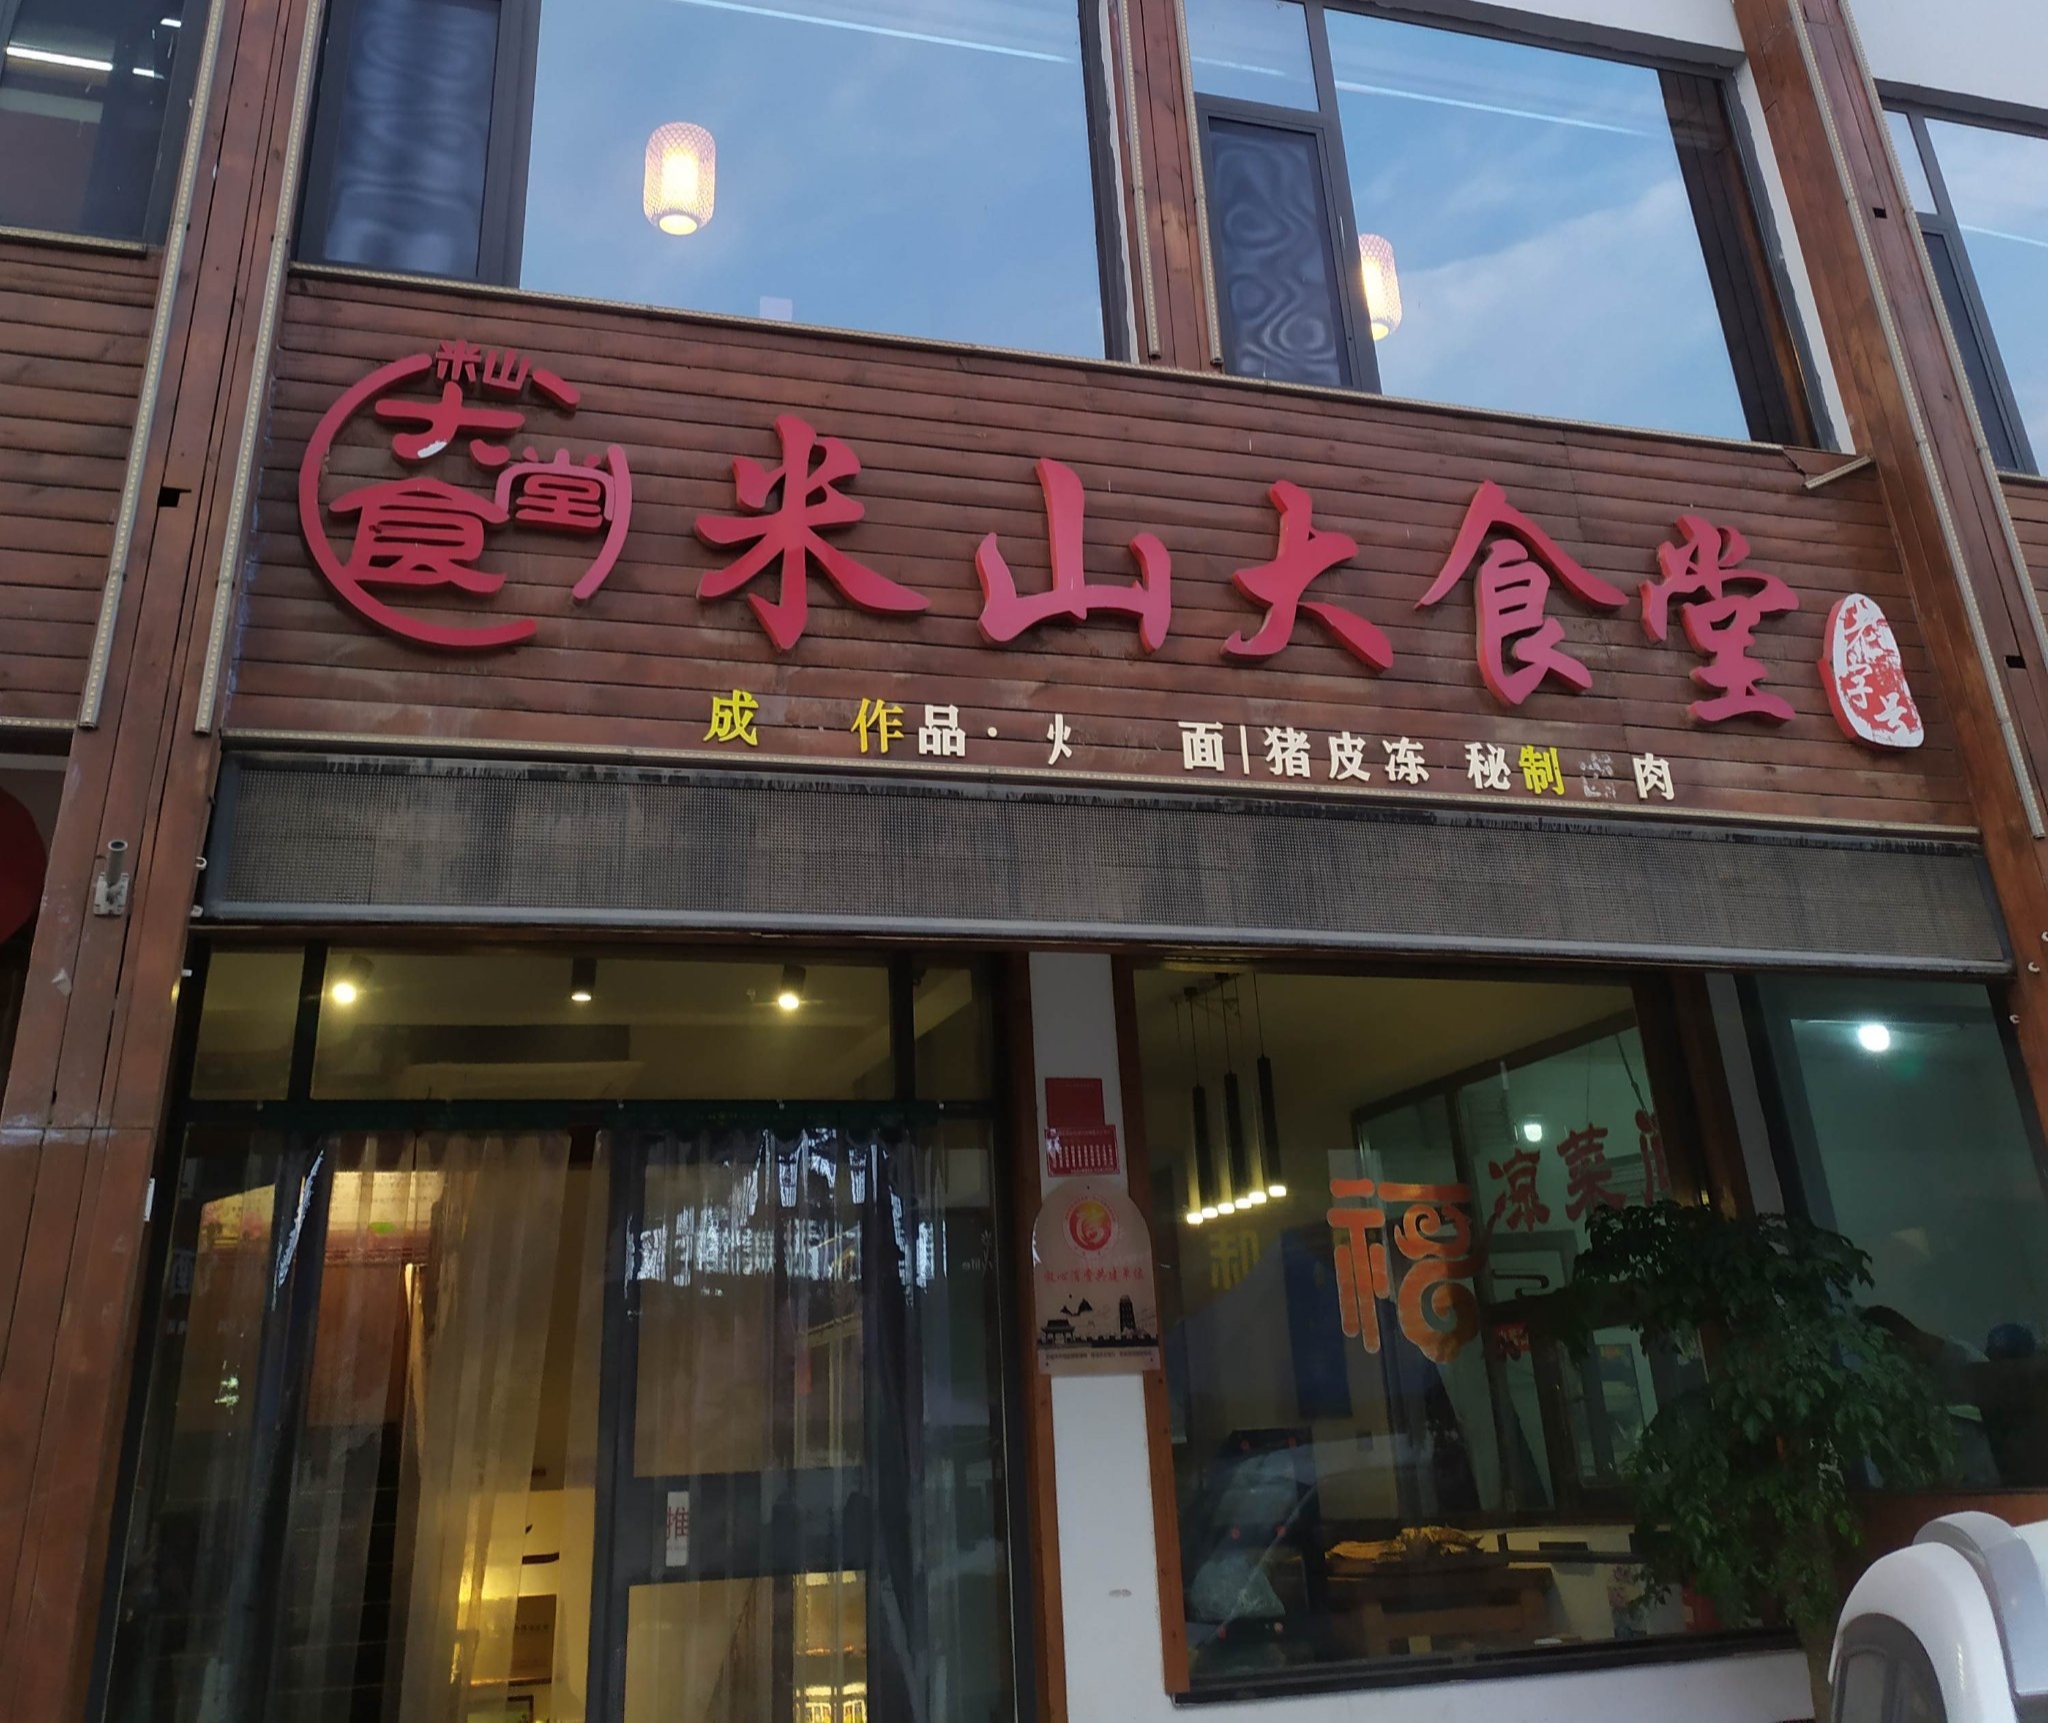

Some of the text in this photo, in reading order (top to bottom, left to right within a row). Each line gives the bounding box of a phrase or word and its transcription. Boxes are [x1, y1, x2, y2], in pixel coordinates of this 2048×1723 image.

[435, 339, 533, 392] 米山
[695, 414, 1799, 723] 米山大食堂
[666, 1506, 689, 1541] 推
